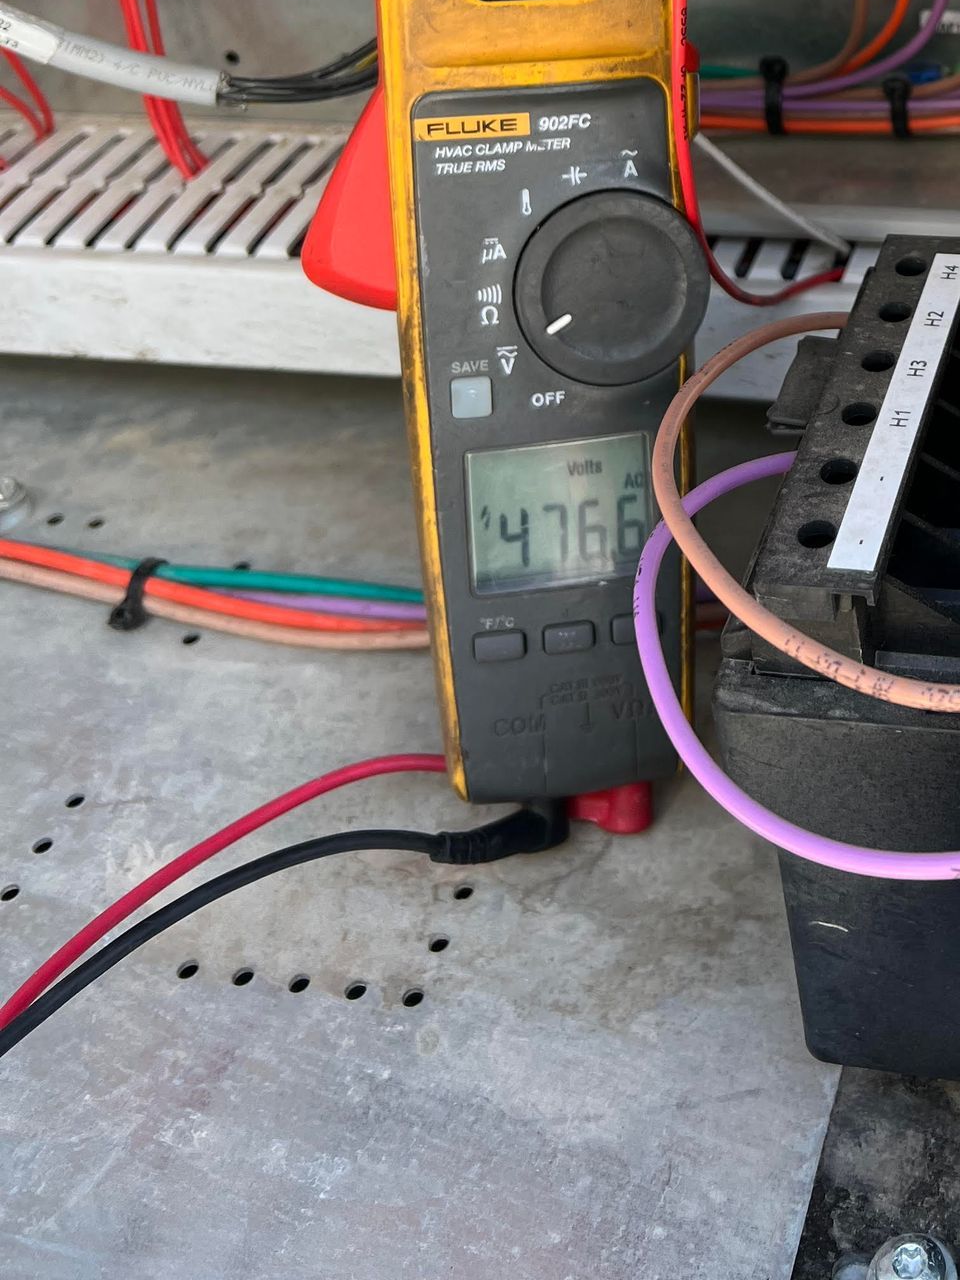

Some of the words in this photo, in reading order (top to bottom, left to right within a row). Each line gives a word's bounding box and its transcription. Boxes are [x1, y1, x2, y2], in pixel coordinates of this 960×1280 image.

[427, 118, 517, 136] FLUKE
[539, 113, 591, 131] 902FC
[434, 145, 472, 159] HVAC
[475, 141, 523, 156] CLAMP
[436, 161, 473, 175] TRUE
[475, 158, 506, 173] RMS
[940, 263, 960, 281] H4
[924, 309, 944, 329] H2
[451, 359, 489, 373] SAVE
[907, 358, 928, 380] H3
[531, 391, 566, 407] OFF
[889, 409, 911, 428] H1
[567, 459, 603, 477] Volts
[624, 472, 644, 489] AC
